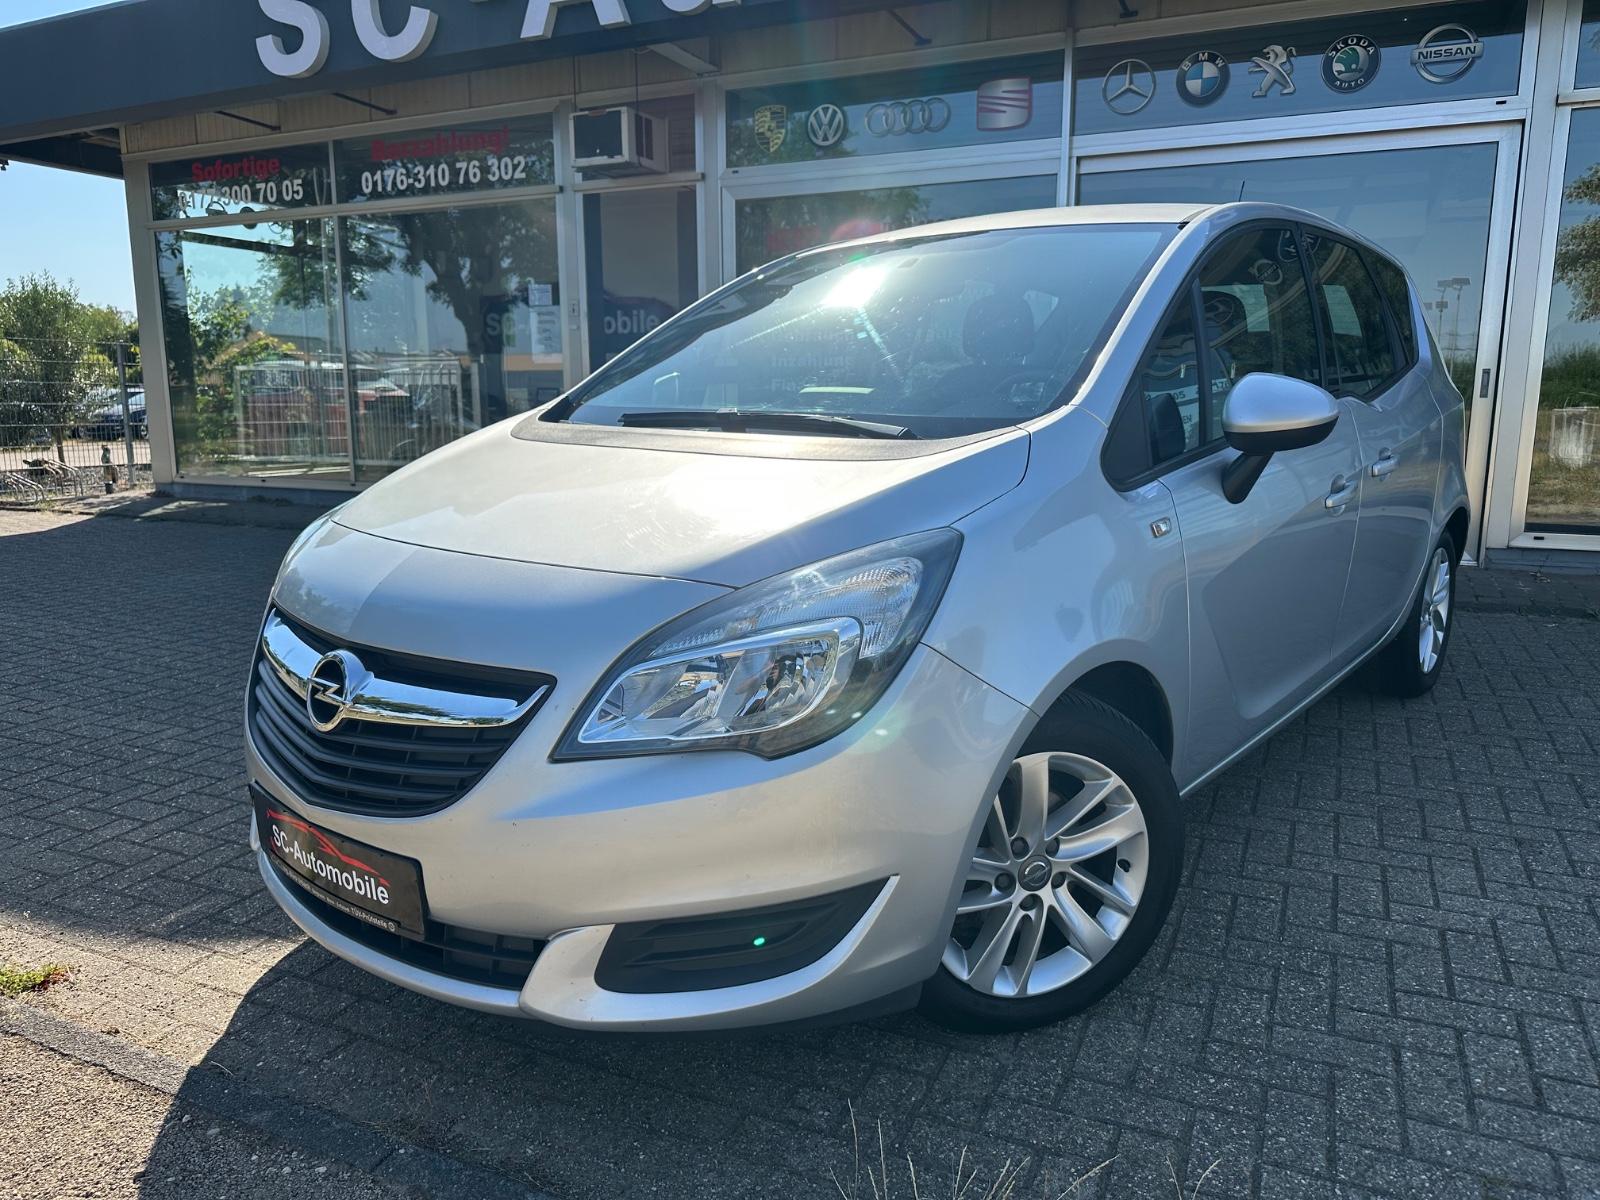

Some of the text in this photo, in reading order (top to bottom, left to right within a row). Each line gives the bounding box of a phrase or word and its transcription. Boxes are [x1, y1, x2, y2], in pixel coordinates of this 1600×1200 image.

[1181, 52, 1226, 72] BMW
[1416, 45, 1477, 61] NISSAN
[1334, 77, 1365, 88] AUTO
[191, 156, 281, 181] Sofortige
[361, 156, 527, 194] 0176-310 76 302
[255, 181, 277, 204] 70
[281, 178, 304, 201] 05
[271, 824, 390, 905] SC-Automobile
